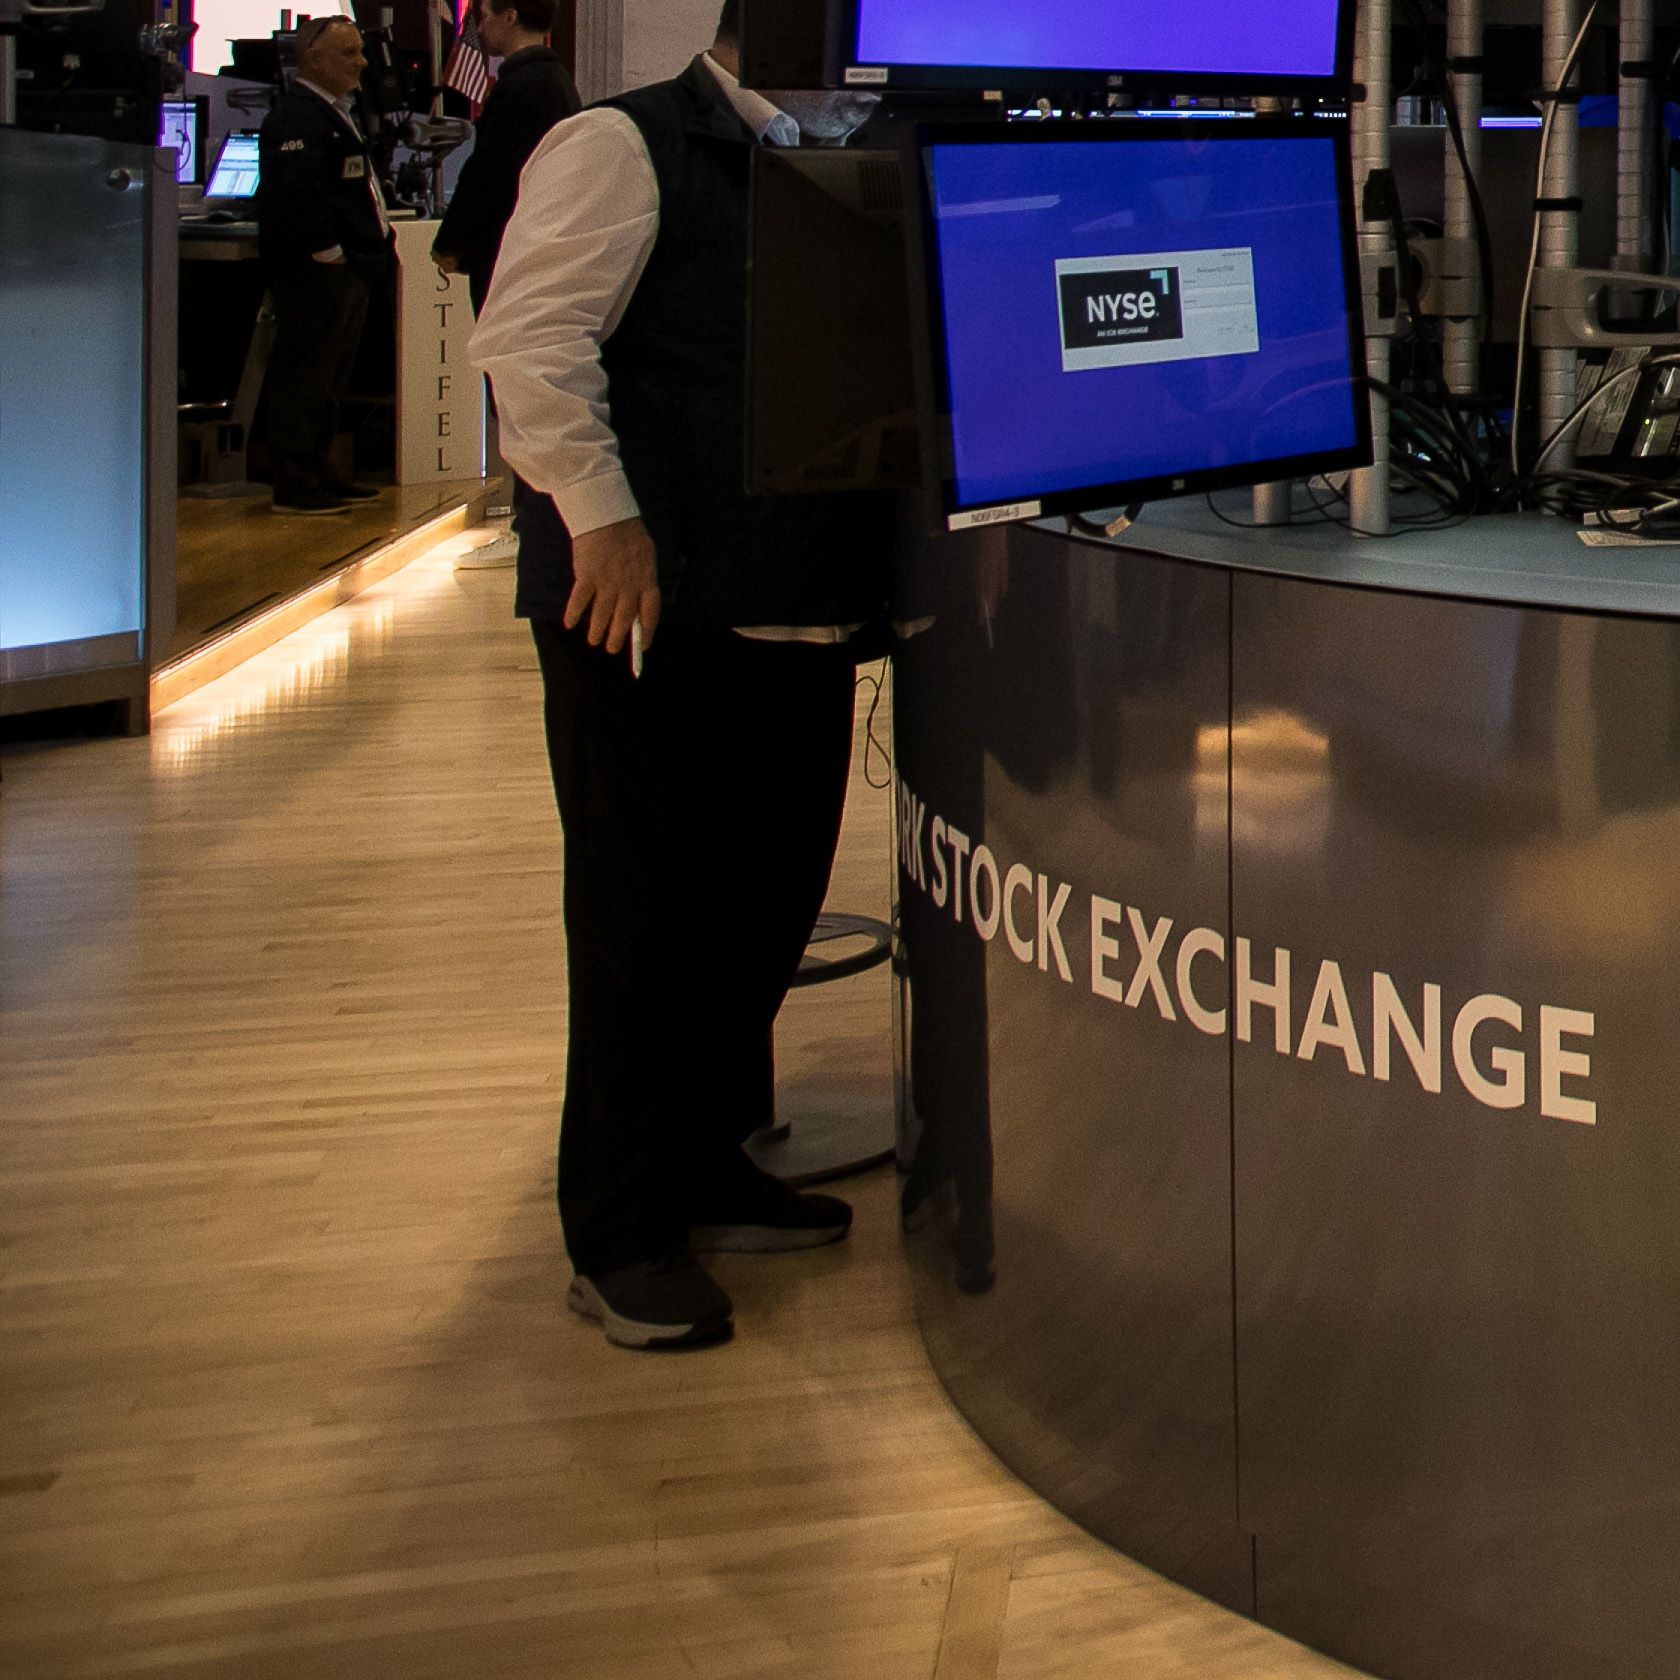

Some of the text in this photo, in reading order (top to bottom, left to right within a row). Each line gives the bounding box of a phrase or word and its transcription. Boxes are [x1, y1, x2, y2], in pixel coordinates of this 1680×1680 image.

[434, 266, 453, 473] STIFEL
[931, 815, 1073, 983] STOCK
[1092, 894, 1597, 1124] EXCHANGE
